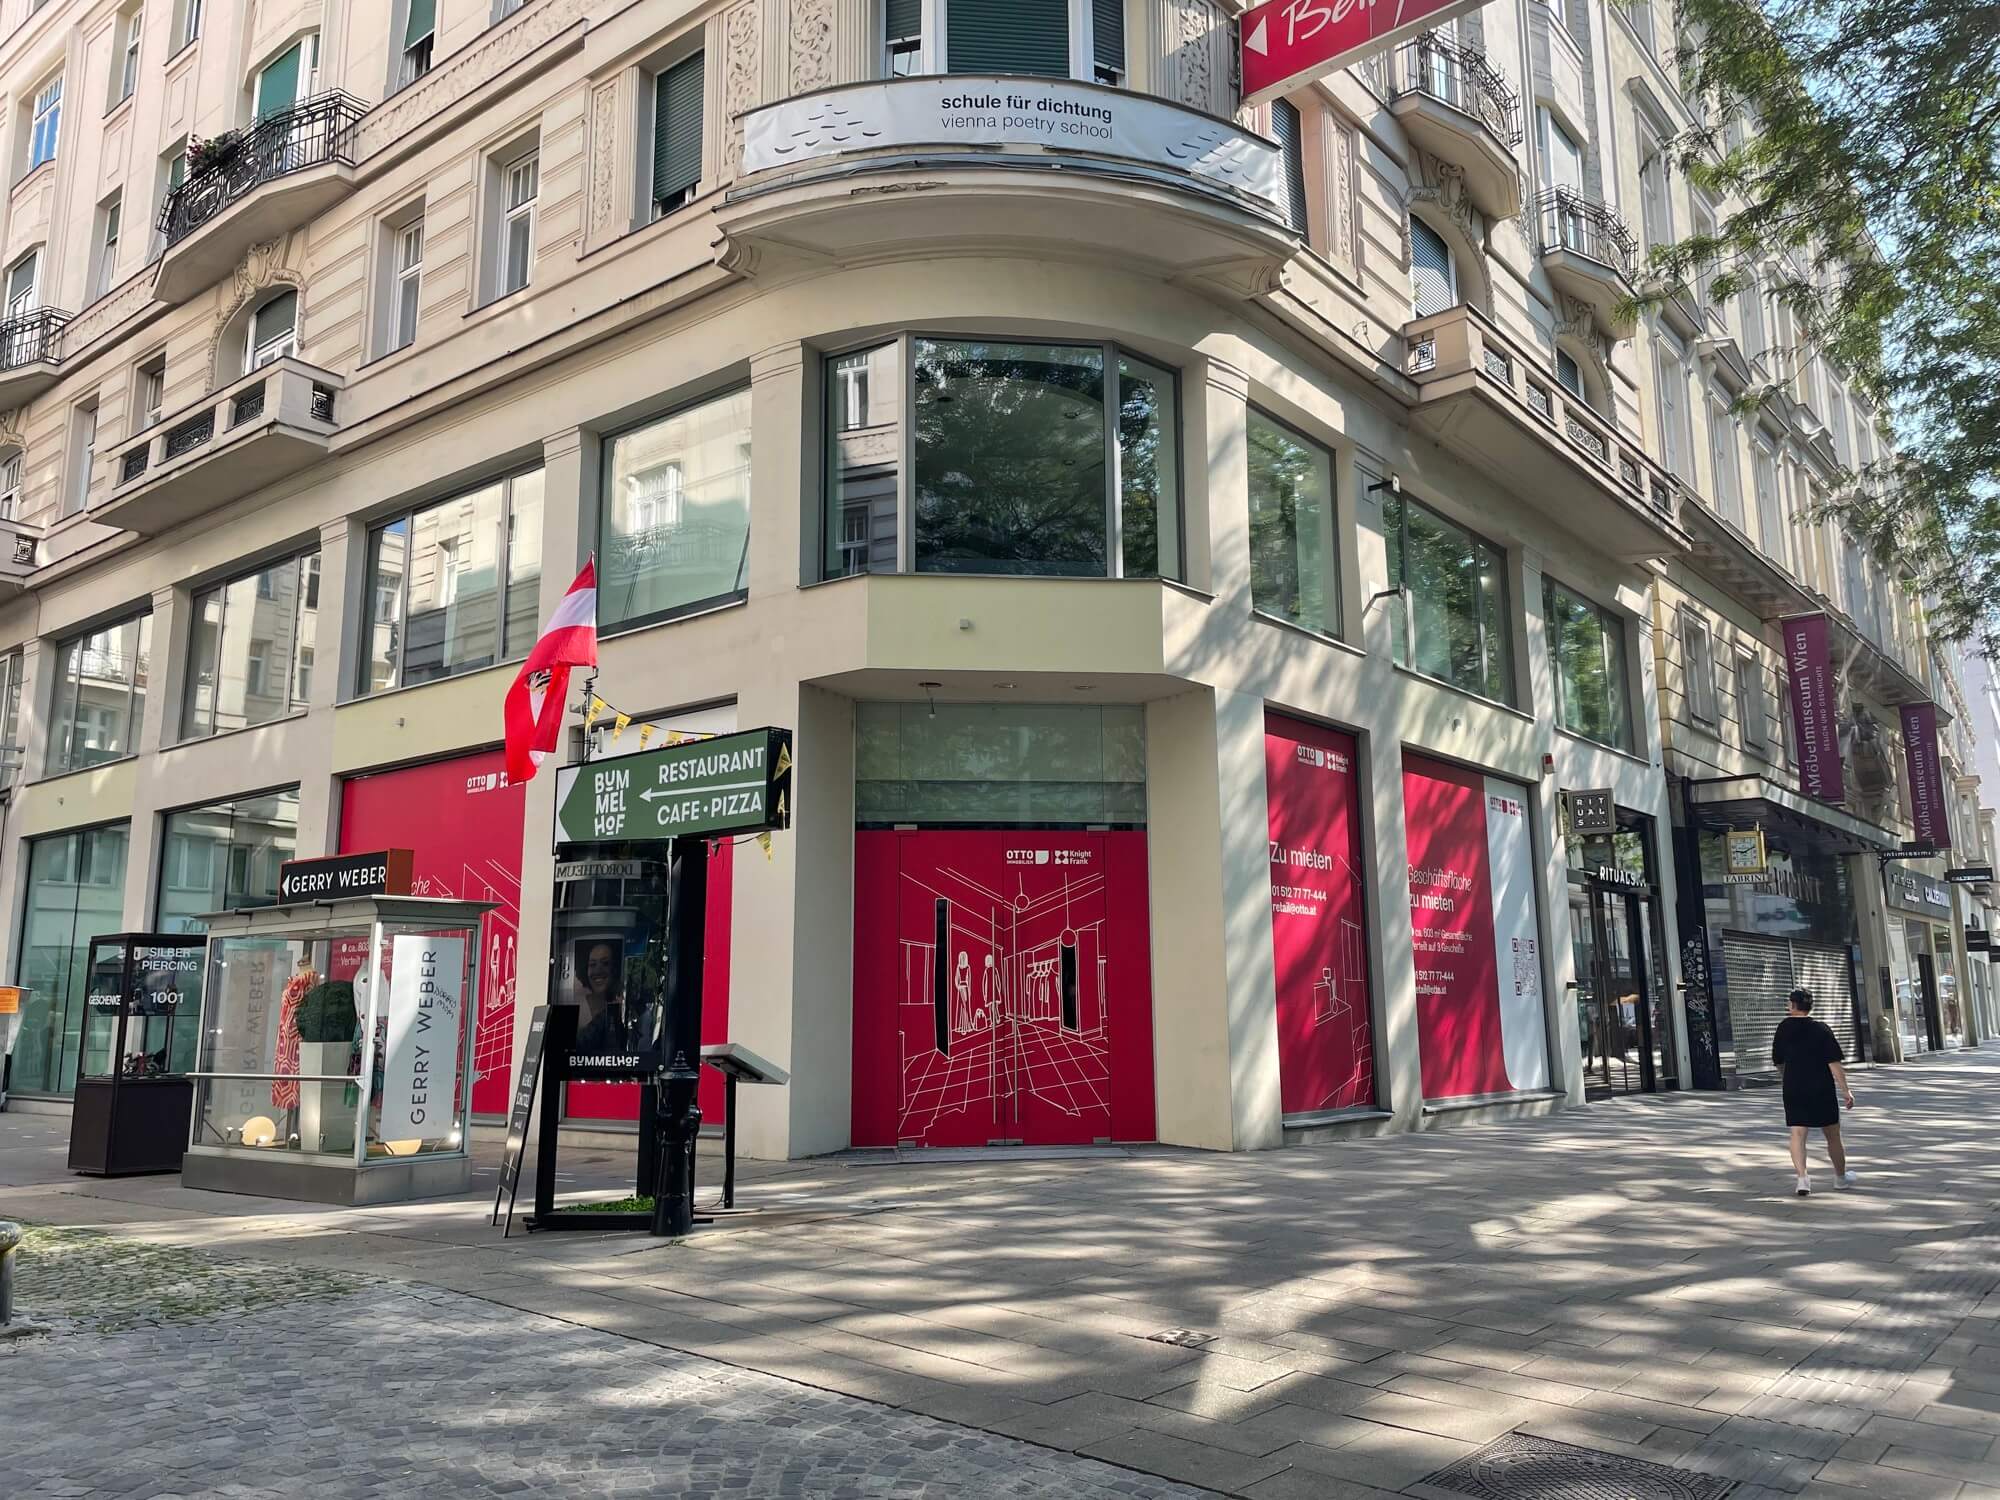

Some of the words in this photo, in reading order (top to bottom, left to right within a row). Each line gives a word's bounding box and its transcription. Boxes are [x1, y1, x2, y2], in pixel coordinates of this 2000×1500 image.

[942, 94, 1001, 109] schule
[1006, 95, 1031, 110] für
[1037, 98, 1112, 124] dichtung
[941, 113, 997, 129] vienna
[1003, 115, 1055, 133] poetry
[1060, 121, 1113, 139] school
[1793, 632, 1808, 673] Wien
[1799, 676, 1822, 789] Möbelmuseum
[1907, 716, 1921, 748] Wien
[658, 747, 765, 784] RESTAURANT
[1297, 746, 1315, 760] OTTO
[467, 775, 486, 788] OTTO
[594, 769, 630, 794] BUM
[595, 789, 627, 815] MEL
[657, 800, 700, 825] CAFE
[711, 792, 763, 818] PIZZA
[594, 814, 625, 836] HOF
[1006, 850, 1034, 859] OTTO
[1070, 850, 1092, 859] Knight
[1270, 841, 1287, 864] Zu
[1290, 846, 1332, 871] mieten
[291, 871, 334, 893] GERRY
[339, 866, 386, 888] WEBER
[1407, 863, 1472, 891] Geschäftsfläche
[1272, 885, 1280, 896] 01
[1280, 886, 1292, 898] 512
[1293, 887, 1302, 899] 77
[1302, 888, 1327, 902] 77-444
[1409, 893, 1419, 908] zu
[1422, 891, 1454, 912] mieten
[1271, 901, 1317, 915] retail@otto.at
[141, 960, 198, 972] PIERCING
[148, 947, 191, 959] SILBER
[150, 991, 185, 1004] 1001
[416, 951, 437, 1035] WEBER
[569, 1055, 641, 1067] BUMMELHOF
[411, 1045, 430, 1125] GERRY
